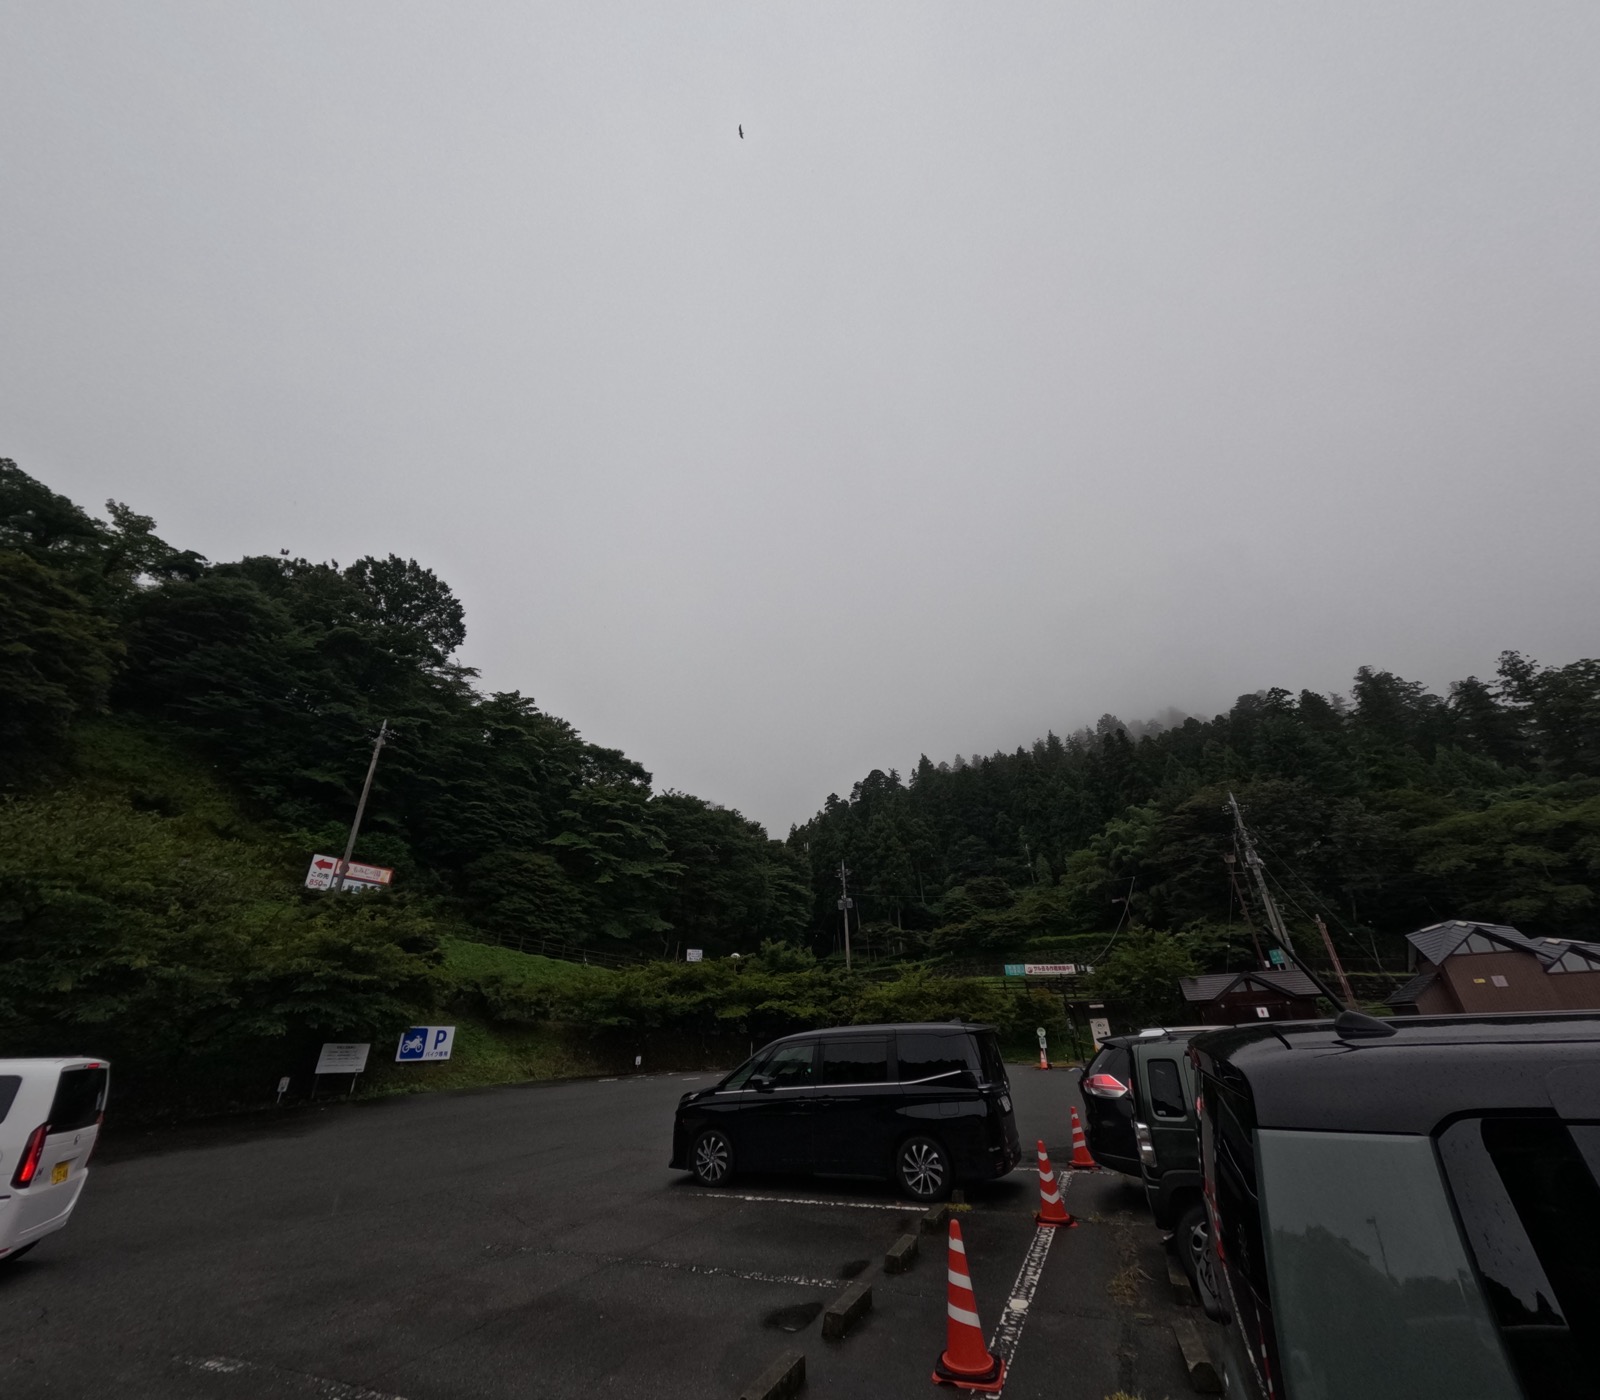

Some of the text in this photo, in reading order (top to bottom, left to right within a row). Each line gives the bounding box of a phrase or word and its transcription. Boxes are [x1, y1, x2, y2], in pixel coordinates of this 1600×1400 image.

[311, 871, 329, 879] この先
[434, 1030, 447, 1050] P
